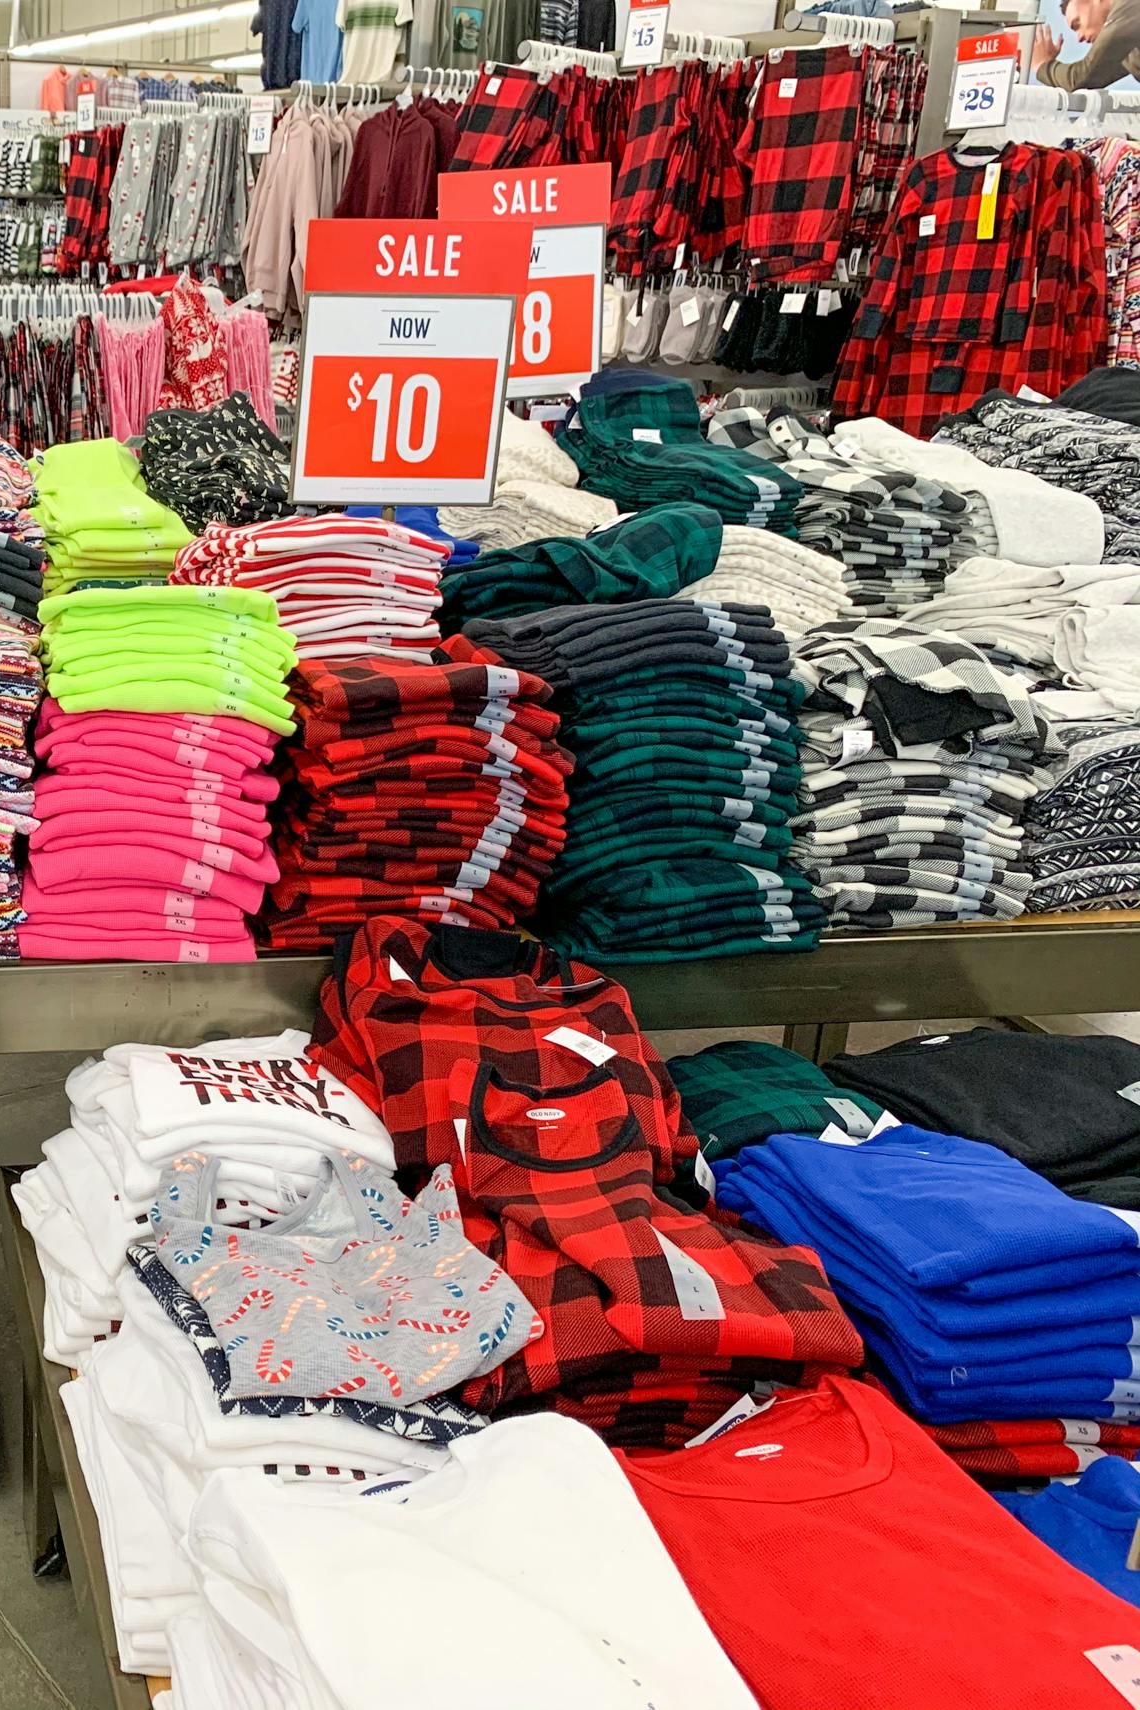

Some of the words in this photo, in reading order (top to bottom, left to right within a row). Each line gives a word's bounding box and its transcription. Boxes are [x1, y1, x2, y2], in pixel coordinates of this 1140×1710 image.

[632, 27, 655, 47] $15
[975, 39, 1000, 54] SALE
[959, 86, 995, 111] $28
[492, 178, 558, 215] SALE
[375, 234, 462, 277] SALE
[389, 317, 431, 339] NOW
[347, 372, 441, 463] $10
[165, 1053, 320, 1082] MERRY
[179, 1065, 345, 1109] EVERY-
[1077, 1426, 1088, 1435] XS
[1111, 1653, 1123, 1662] M
